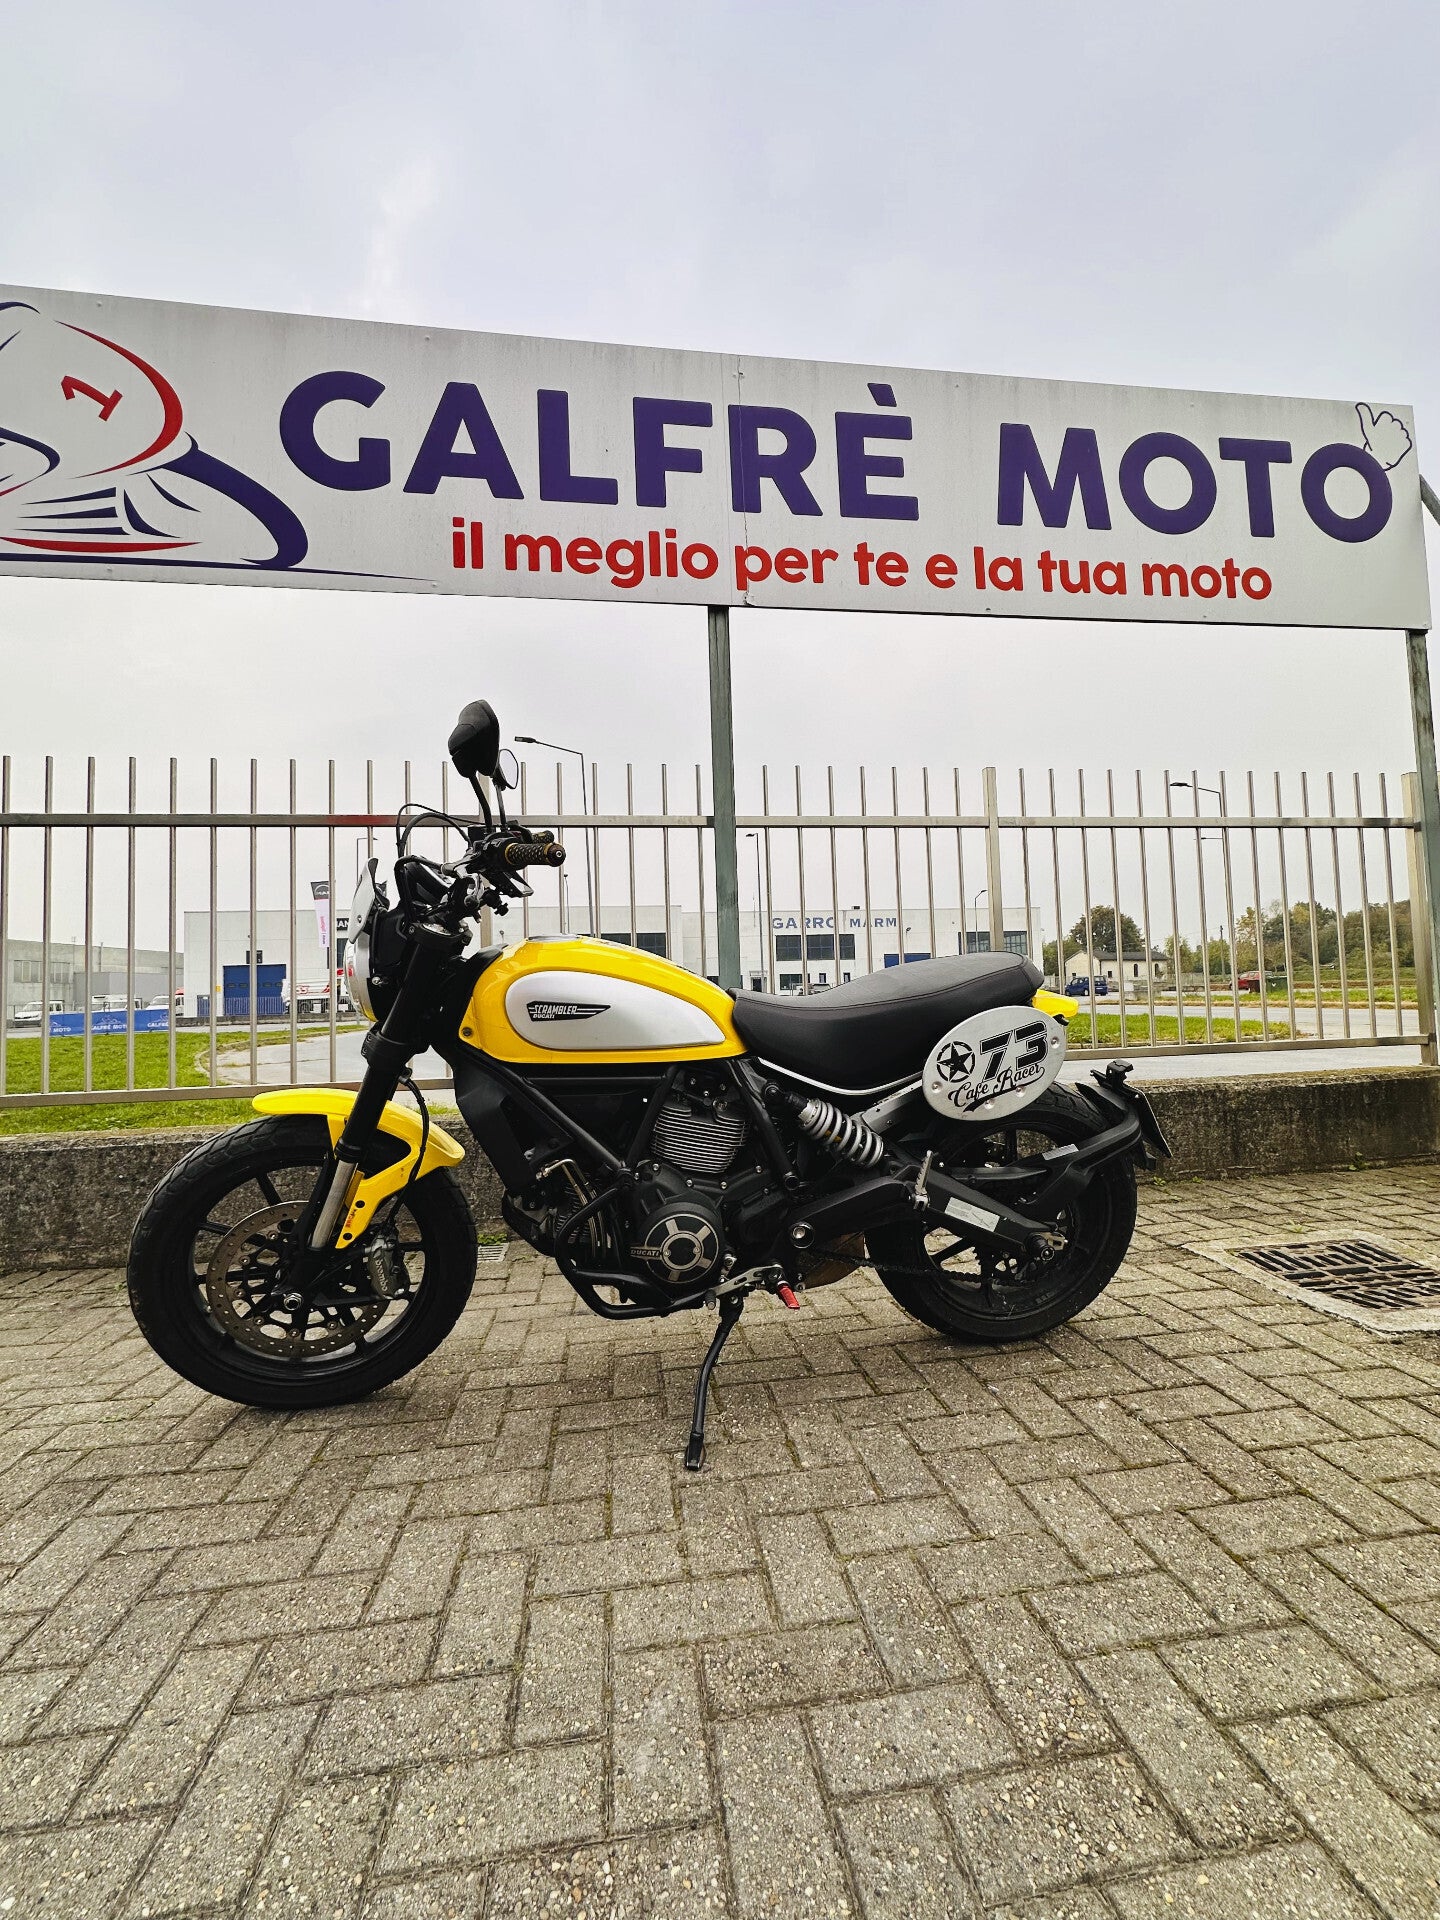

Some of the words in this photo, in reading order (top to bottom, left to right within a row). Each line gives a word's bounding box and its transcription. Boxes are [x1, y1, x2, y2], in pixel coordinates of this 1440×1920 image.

[281, 371, 918, 520] GALFRÈ
[998, 424, 1392, 541] MOTO
[452, 516, 484, 570] il
[505, 529, 719, 589] meglio
[735, 545, 838, 591] per
[854, 542, 908, 587] te
[926, 553, 958, 589] e
[973, 546, 1024, 592] la
[1037, 550, 1127, 595] tua
[1142, 558, 1272, 600] moto
[534, 1004, 578, 1015] SCRAMBLER
[979, 1020, 1049, 1083] 73
[948, 1081, 990, 1108] Cafe
[992, 1062, 1042, 1094] Racer
[630, 1249, 660, 1257] DUCATI
